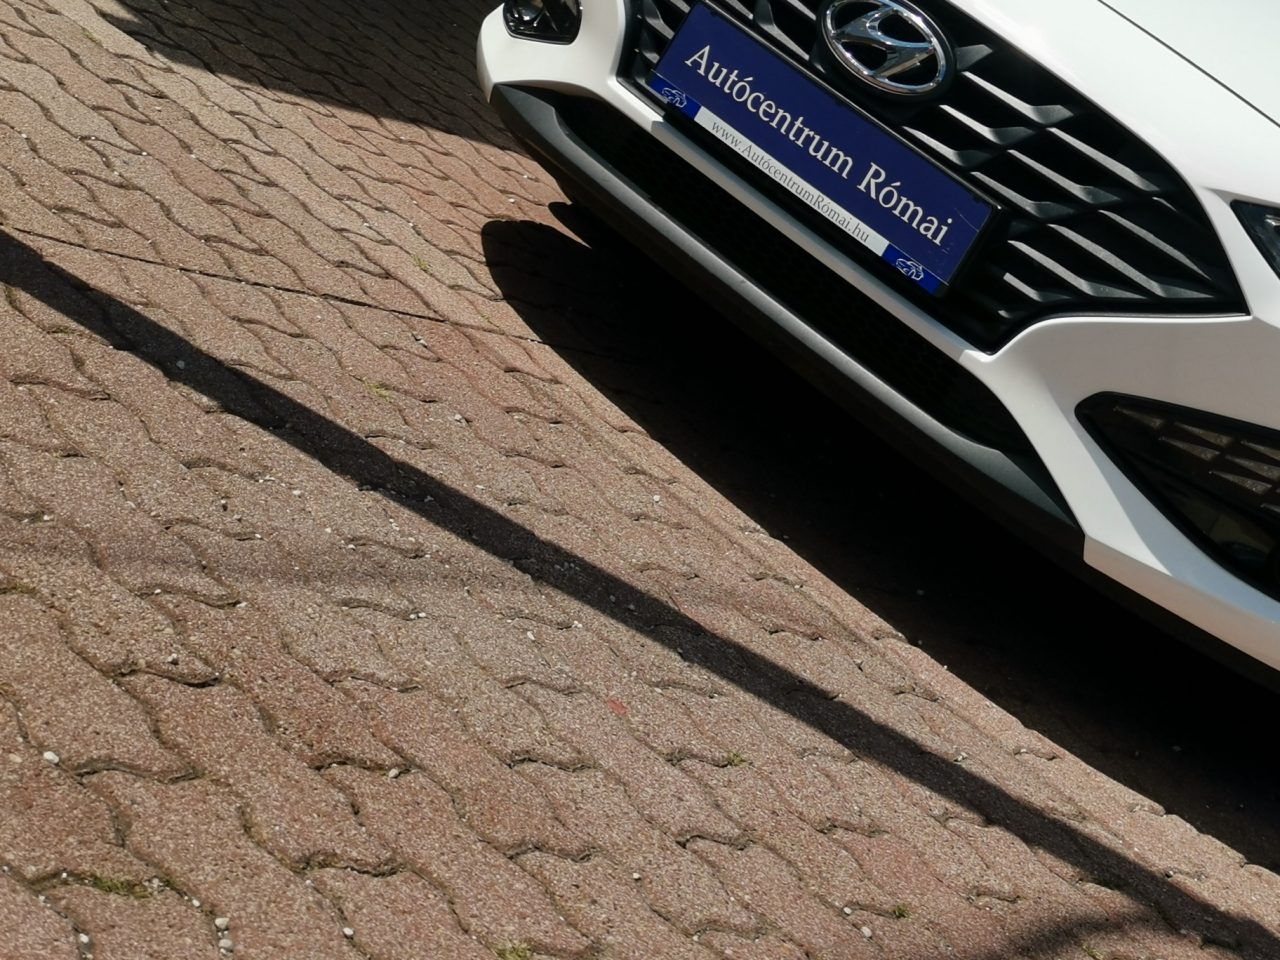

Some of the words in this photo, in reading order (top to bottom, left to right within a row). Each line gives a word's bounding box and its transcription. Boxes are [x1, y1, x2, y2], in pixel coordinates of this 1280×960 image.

[684, 44, 854, 179] Autócentrum
[856, 162, 953, 246] Római
[711, 121, 870, 244] www.AutócentrumRómai.hu
